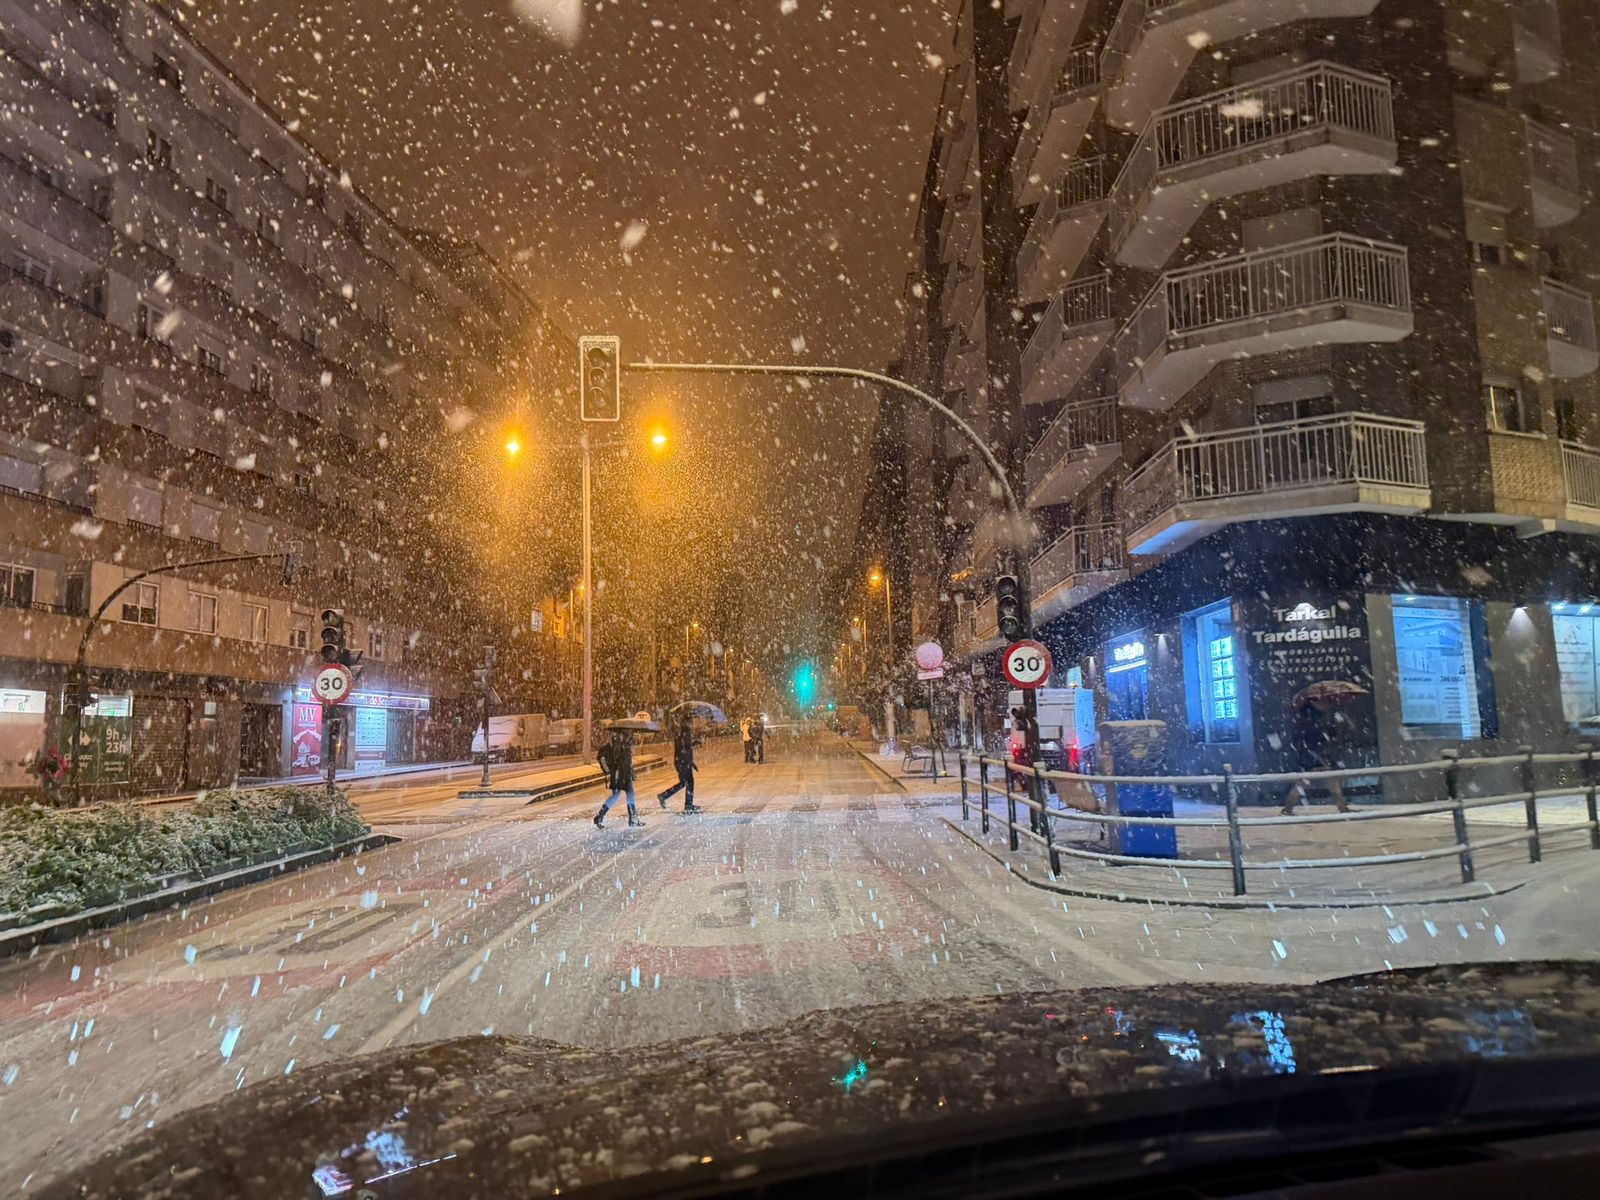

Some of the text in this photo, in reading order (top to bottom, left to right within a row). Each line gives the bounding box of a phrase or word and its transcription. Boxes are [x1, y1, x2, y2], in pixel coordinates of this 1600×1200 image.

[1273, 606, 1337, 622] Tarkal
[1252, 626, 1362, 643] Tardáguila
[1269, 647, 1347, 656] IOBILIARIA
[1013, 657, 1040, 672] 30
[320, 677, 343, 691] 30
[106, 728, 119, 740] 9h
[106, 742, 126, 753] 23h
[697, 881, 838, 929] 30
